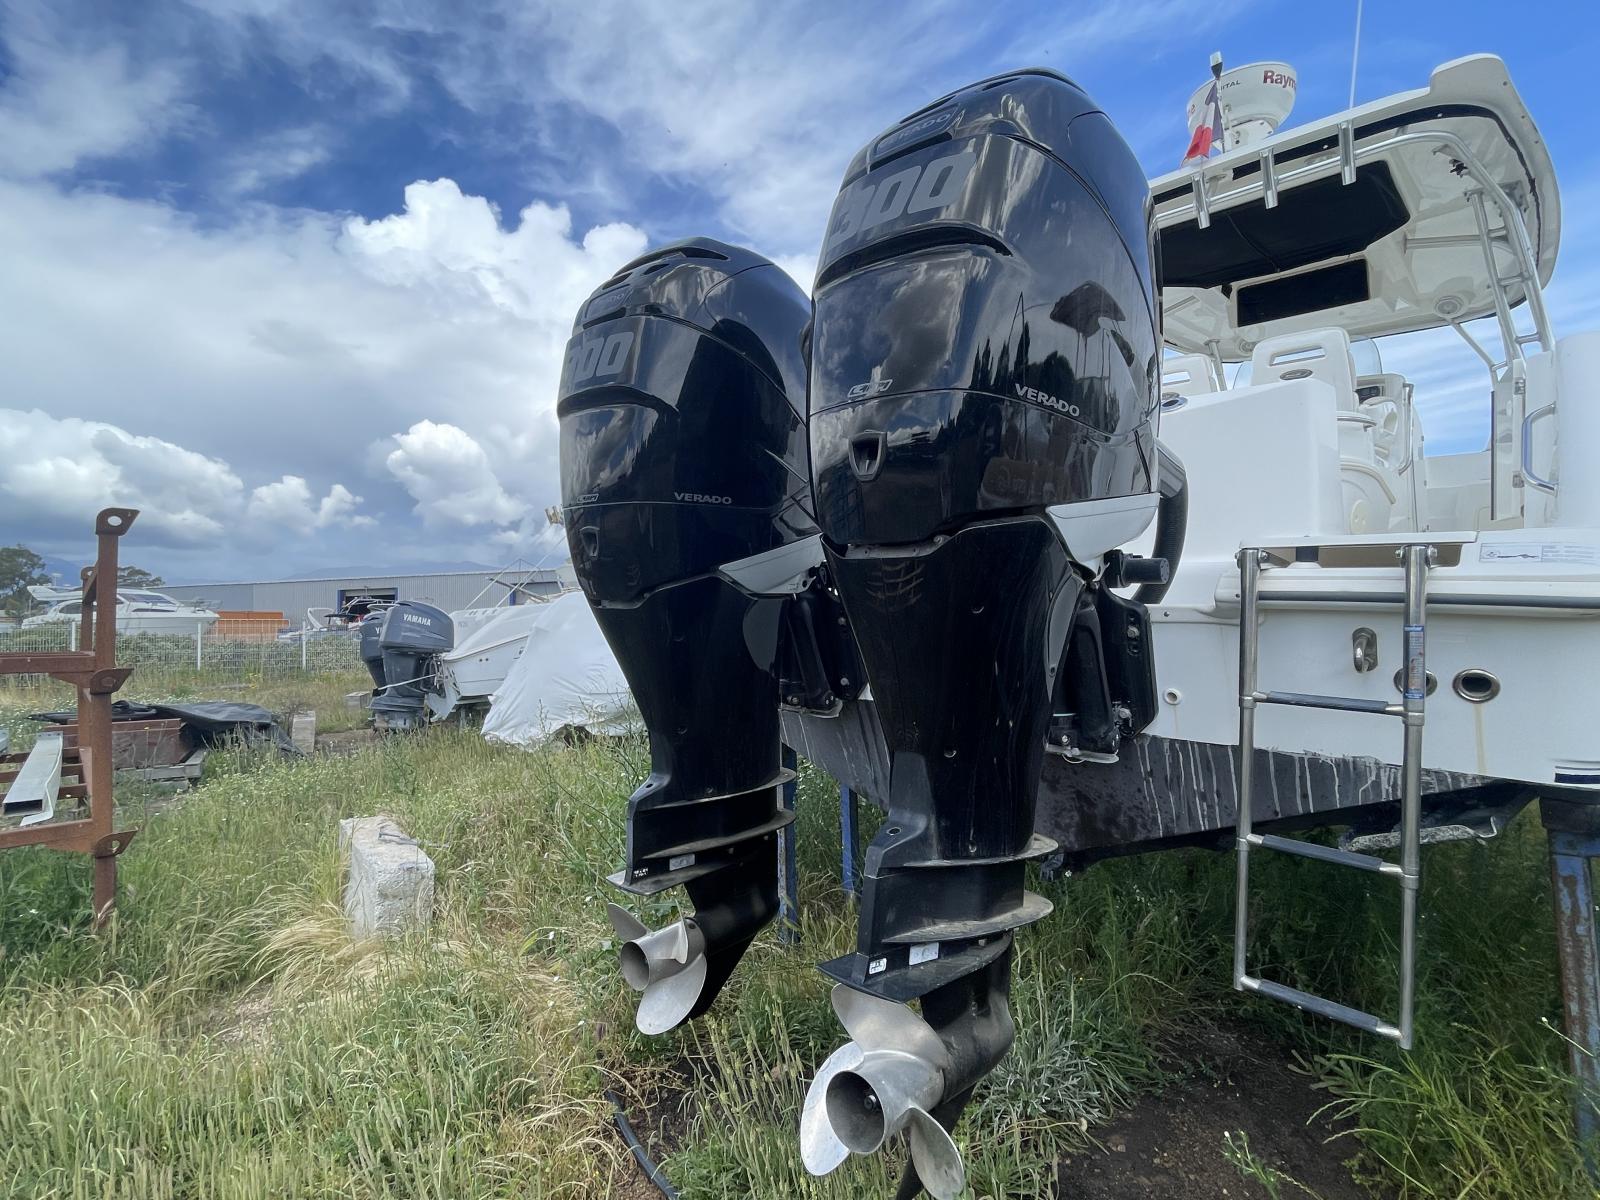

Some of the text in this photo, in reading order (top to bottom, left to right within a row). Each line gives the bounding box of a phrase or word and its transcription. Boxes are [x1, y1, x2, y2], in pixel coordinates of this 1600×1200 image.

[1015, 383, 1080, 418] VERADO
[673, 491, 732, 505] VERADO
[403, 613, 431, 626] YAMAHA
